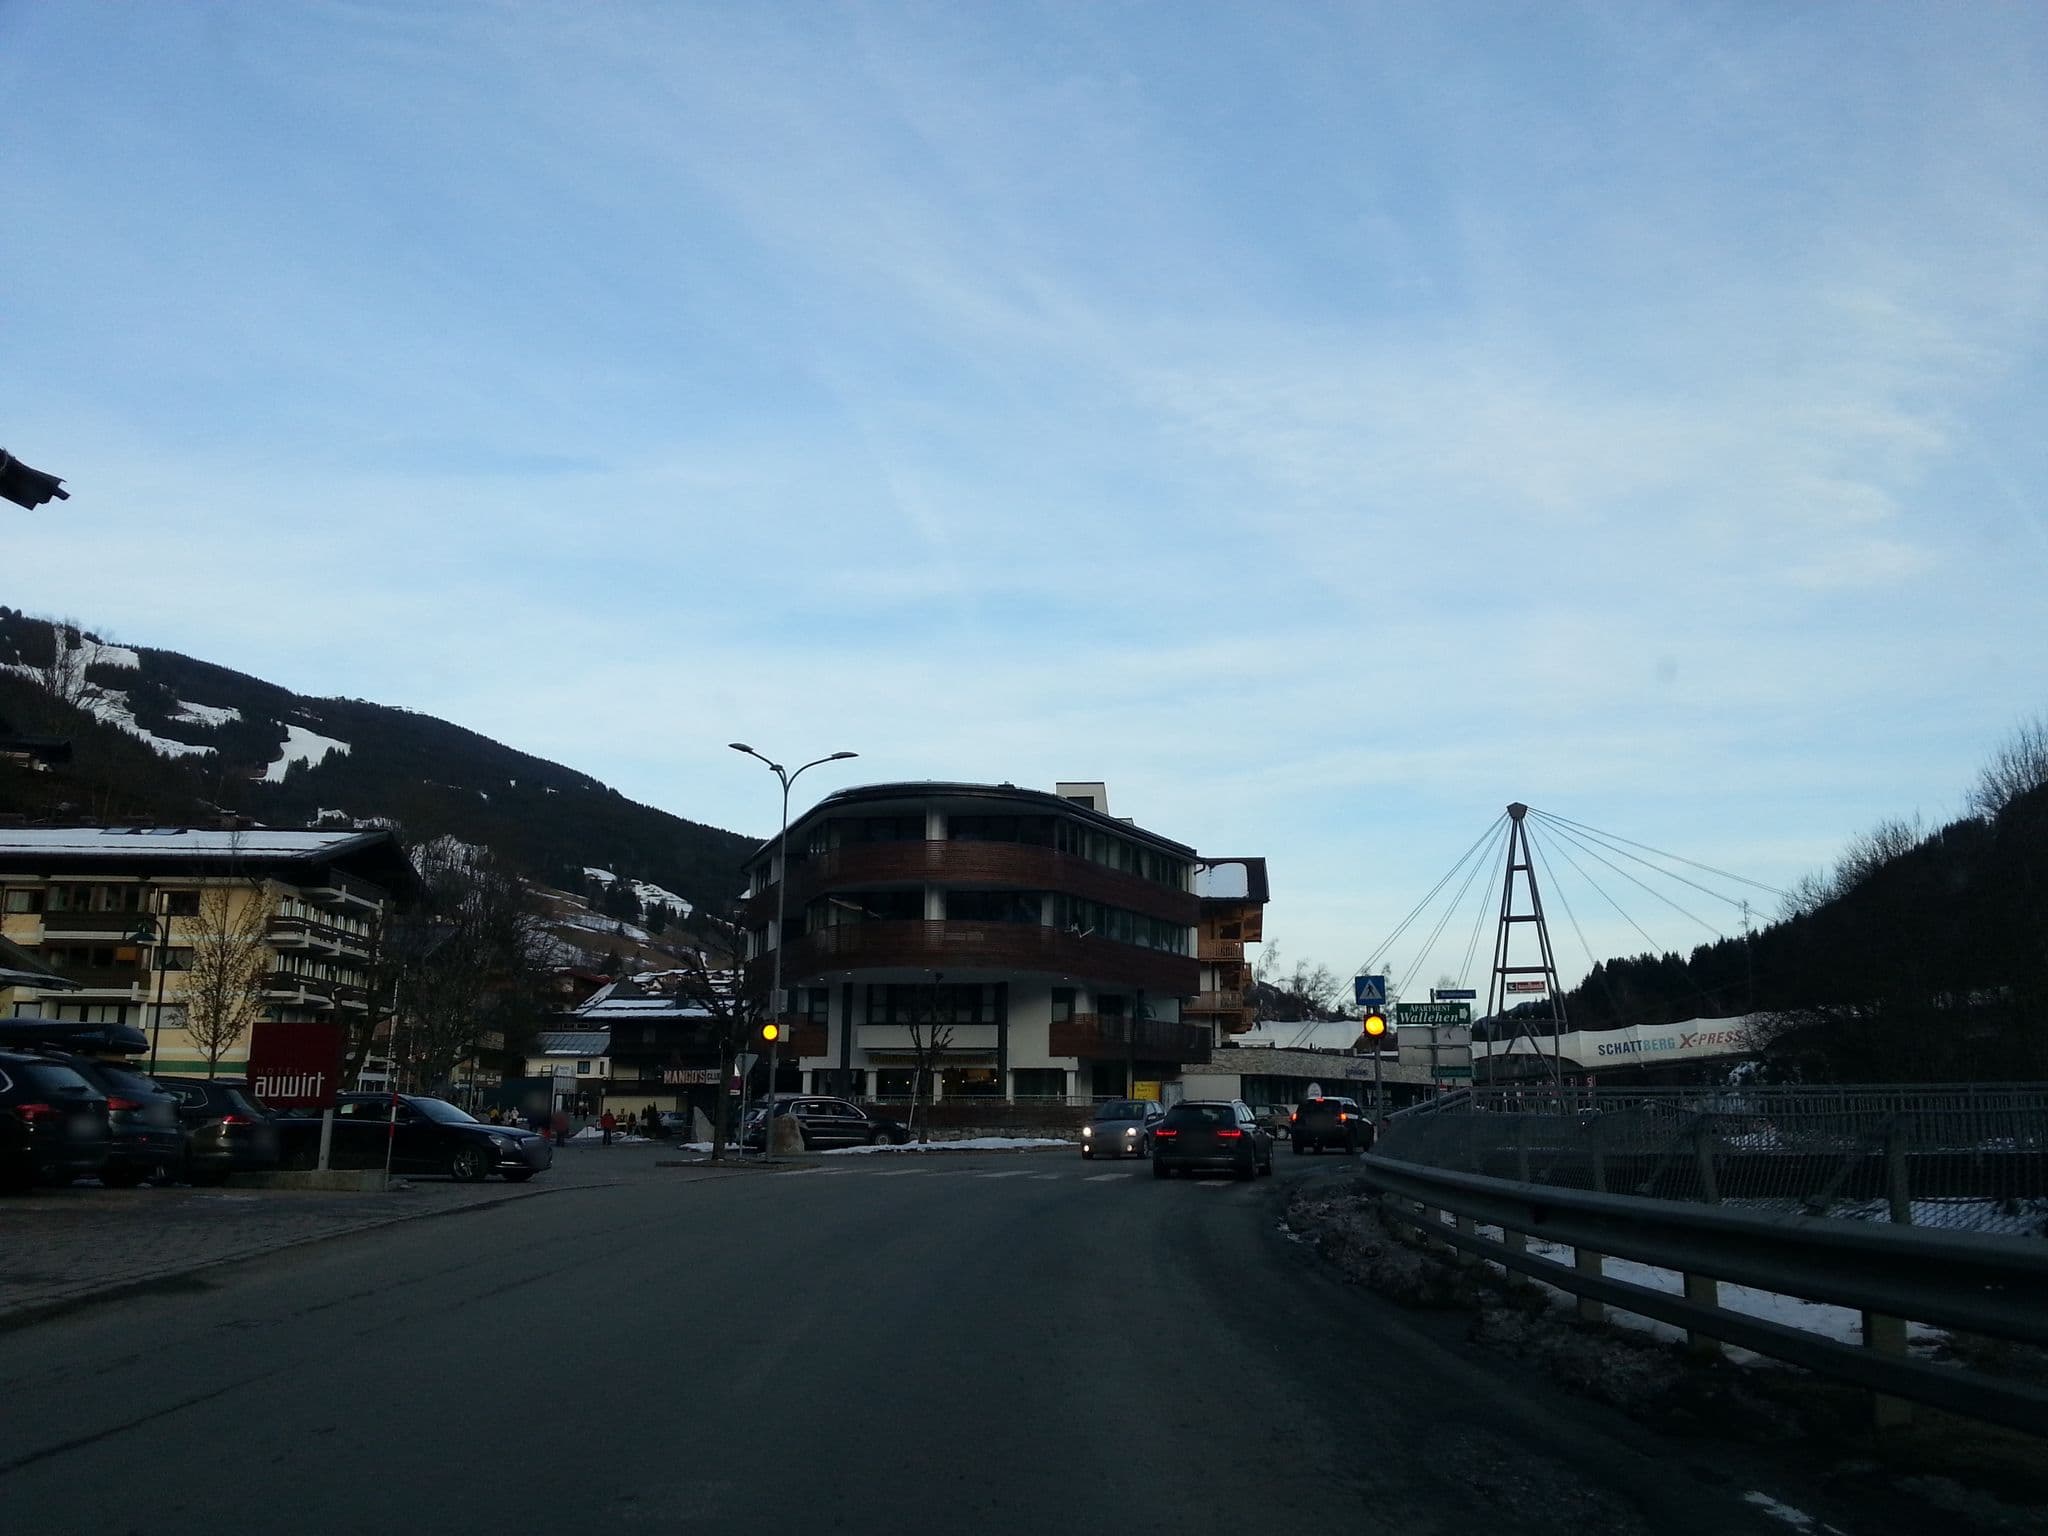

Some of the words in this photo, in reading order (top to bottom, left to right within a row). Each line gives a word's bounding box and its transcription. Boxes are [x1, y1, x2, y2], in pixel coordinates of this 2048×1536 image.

[1598, 1037, 1676, 1056] SCHATTBERG
[1679, 1030, 1744, 1050] X-PRESS
[255, 1072, 325, 1098] auwirt
[663, 1070, 706, 1085] MANGO'S
